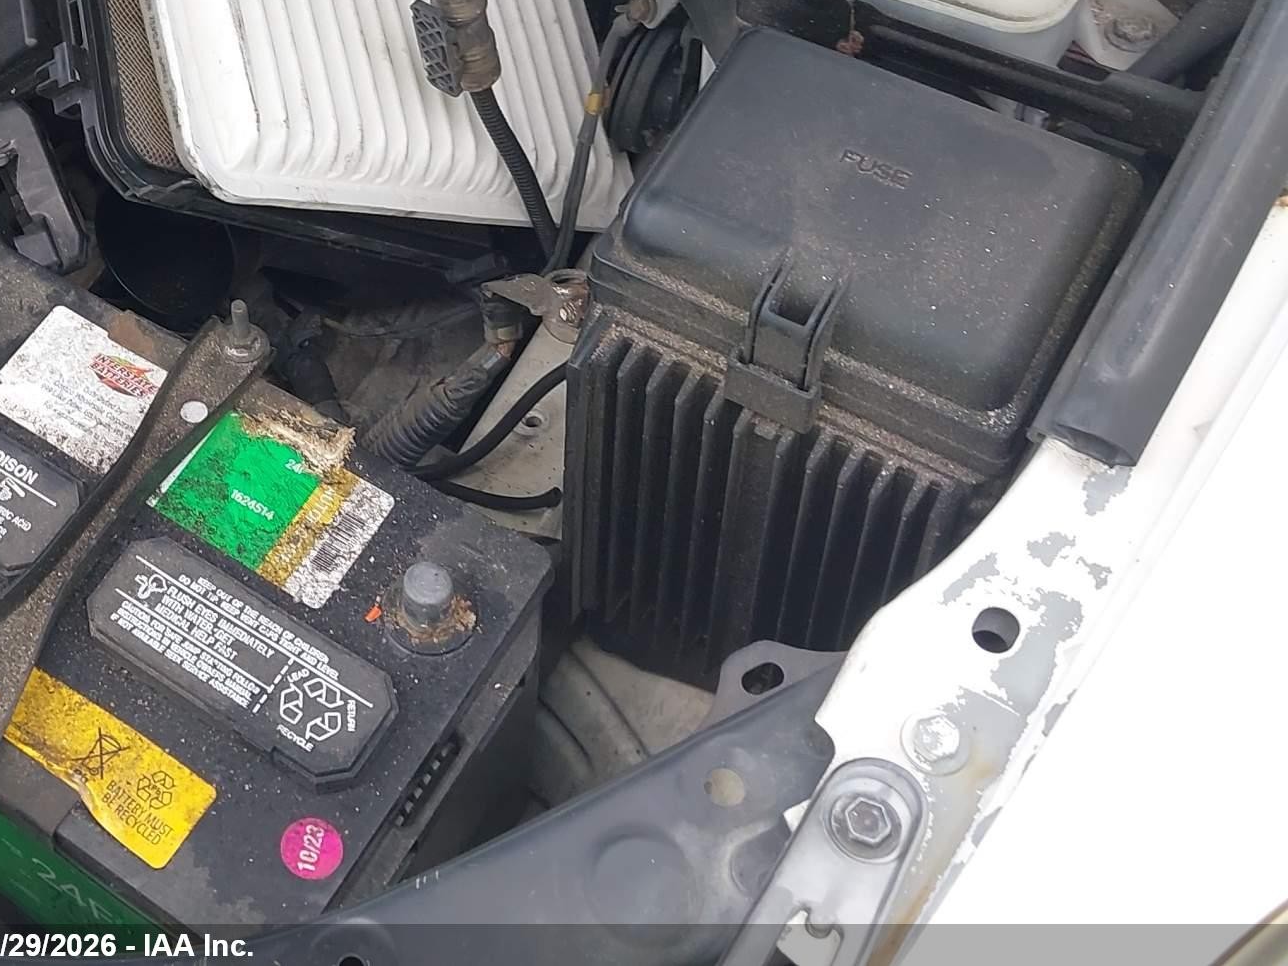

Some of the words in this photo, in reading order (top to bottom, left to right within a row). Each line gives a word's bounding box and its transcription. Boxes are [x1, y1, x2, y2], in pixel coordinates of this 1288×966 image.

[839, 148, 913, 190] FUSE
[90, 362, 146, 398] BATTERIES
[94, 353, 158, 393] INTERSTATE
[231, 490, 274, 520] 1624514
[11, 516, 32, 532] ACID
[161, 594, 185, 614] WITH
[190, 581, 206, 595] NOT
[216, 589, 233, 602] OUT
[154, 603, 190, 632] MEDICAL
[190, 626, 215, 645] HELP
[213, 641, 238, 660] FAST
[166, 586, 196, 610] FLUSH
[194, 604, 218, 623] EYES
[217, 618, 275, 658] IMMEDIATELY
[286, 668, 310, 684] LEAD
[347, 698, 358, 733] RETURN
[276, 724, 315, 753] RECYCLE
[101, 792, 116, 808] BE
[114, 804, 161, 845] RECYCLED
[106, 779, 145, 818] BATTERY
[144, 812, 174, 838] MUST
[297, 824, 325, 872] 10/23
